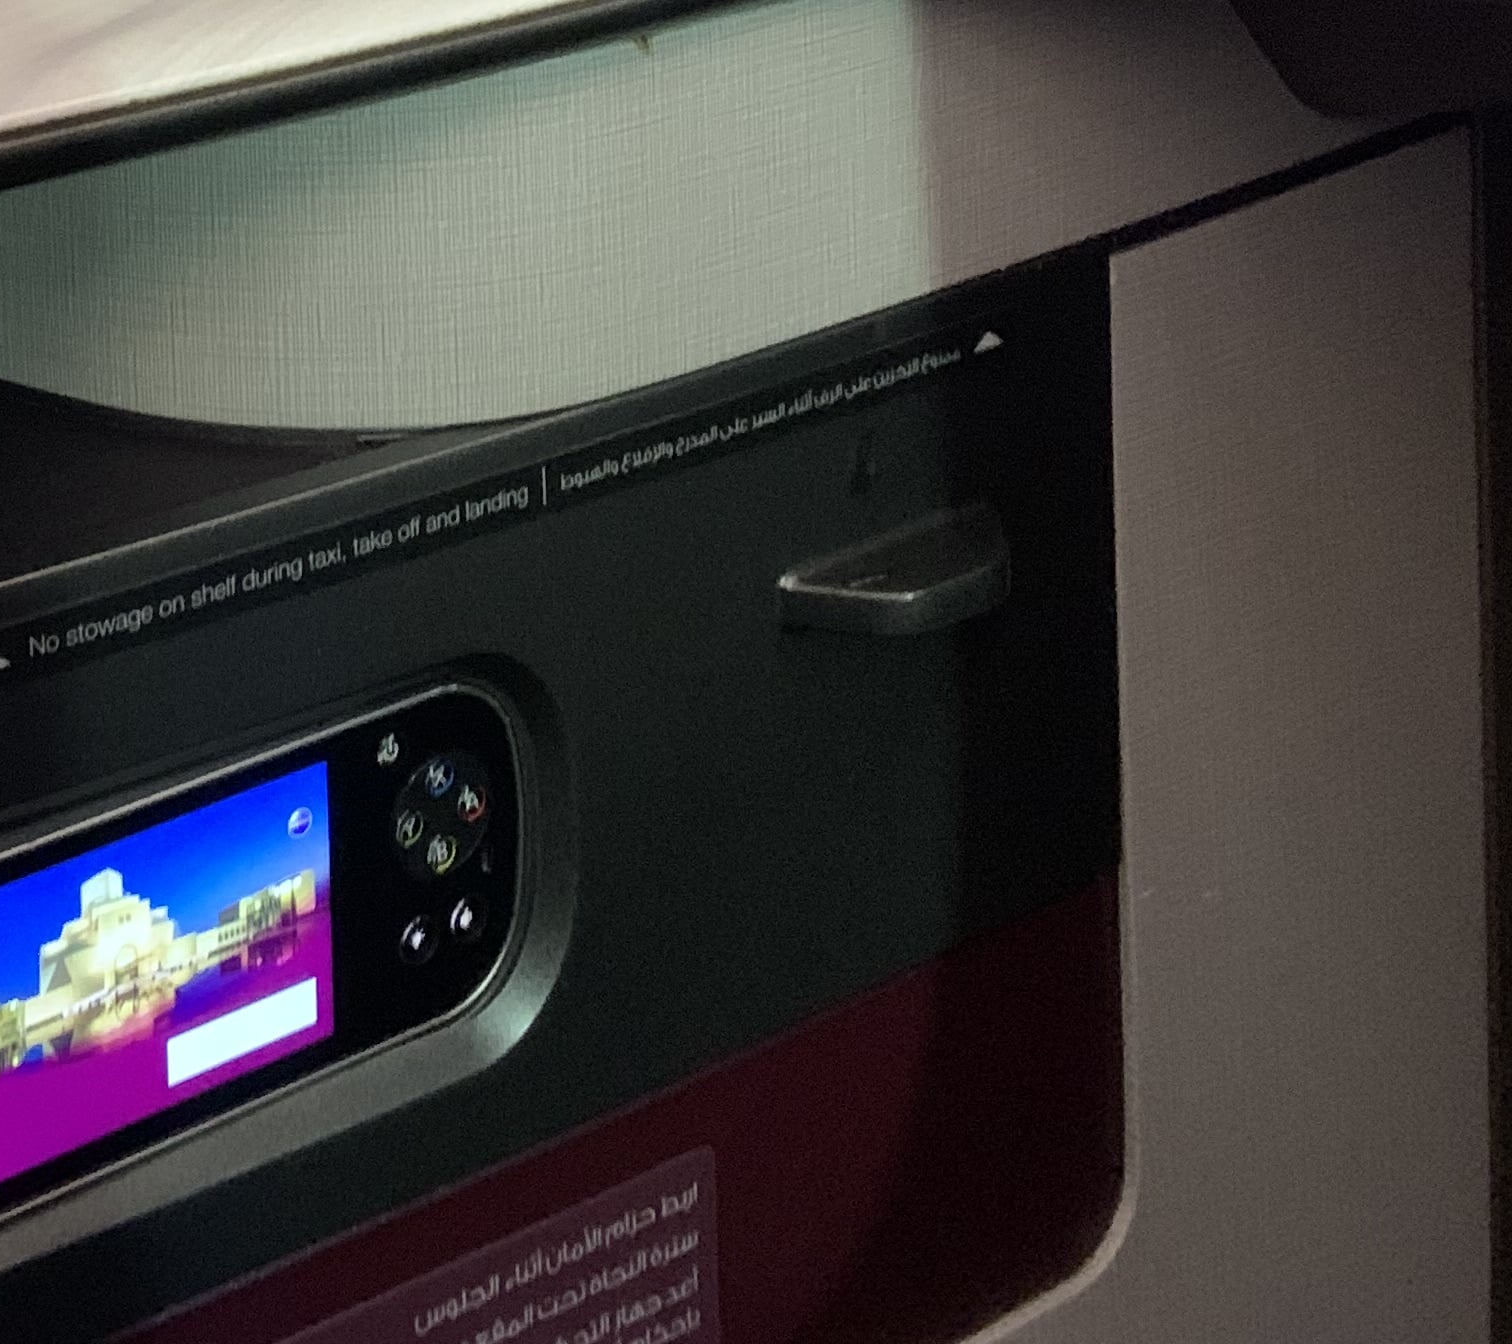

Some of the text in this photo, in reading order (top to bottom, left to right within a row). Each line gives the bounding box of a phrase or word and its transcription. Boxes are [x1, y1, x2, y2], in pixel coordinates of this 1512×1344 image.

[719, 417, 749, 441] على
[560, 459, 620, 491] والهبوط
[28, 484, 530, 658] No stowage on shelf during taxi, take off and landing
[414, 1181, 699, 1337] اربط حزام الأمان أثناء الجلوس
[650, 1229, 700, 1267] سترة
[537, 1279, 586, 1321] تحت
[461, 1302, 534, 1344] المقع
